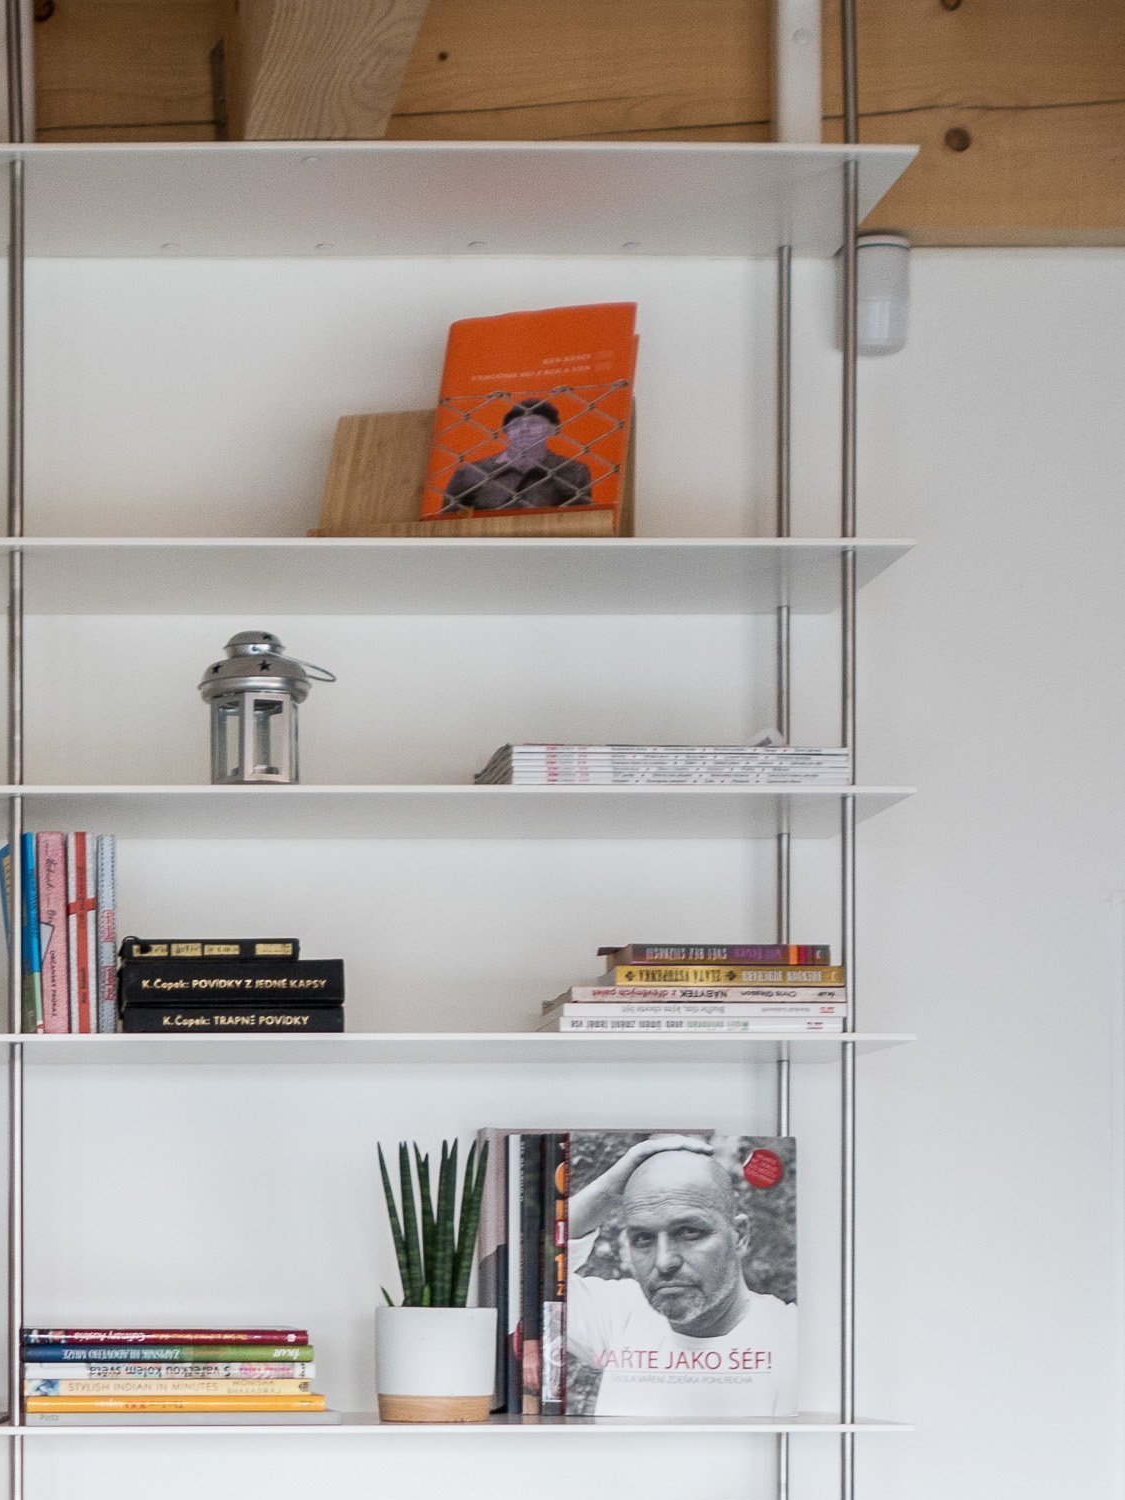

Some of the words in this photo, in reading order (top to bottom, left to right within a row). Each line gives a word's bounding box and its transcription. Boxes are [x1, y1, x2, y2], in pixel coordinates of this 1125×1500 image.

[192, 977, 242, 989] POVÍDKY
[244, 978, 252, 989] Z
[254, 977, 287, 990] JEDNÉ
[289, 979, 328, 990] KAPSY
[680, 988, 728, 1000] NÁBYTEK
[775, 989, 797, 999] Chris
[214, 1014, 256, 1026] TRAPNÉ
[258, 1014, 310, 1026] POVÍDKY
[593, 1346, 659, 1370] VAŘTE
[664, 1349, 722, 1370] JAKO
[728, 1346, 772, 1370] ŠÉF!
[89, 1366, 122, 1378] světa
[124, 1366, 162, 1377] kolem
[166, 1365, 221, 1378] vařečkou
